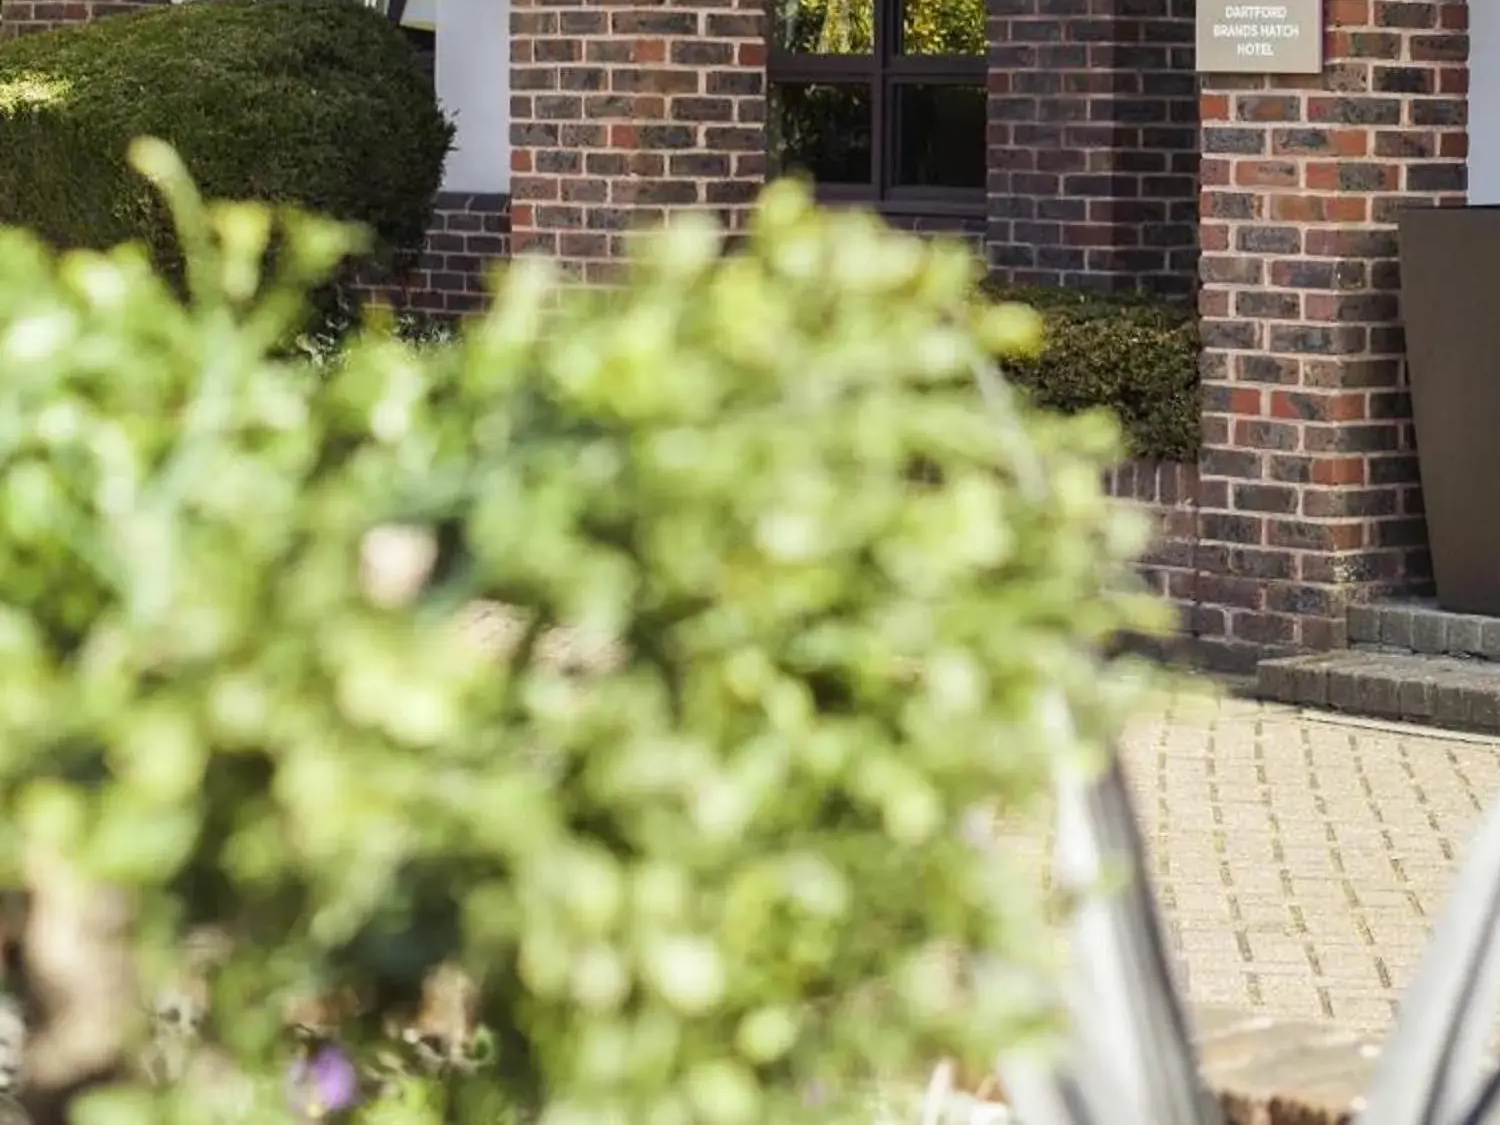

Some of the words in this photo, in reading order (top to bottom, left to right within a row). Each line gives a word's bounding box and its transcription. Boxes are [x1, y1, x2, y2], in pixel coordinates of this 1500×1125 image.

[1225, 5, 1288, 20] DARTFORD
[1213, 24, 1259, 38] BRANDS
[1261, 24, 1300, 38] HATCH
[1236, 41, 1275, 57] HOTEL
